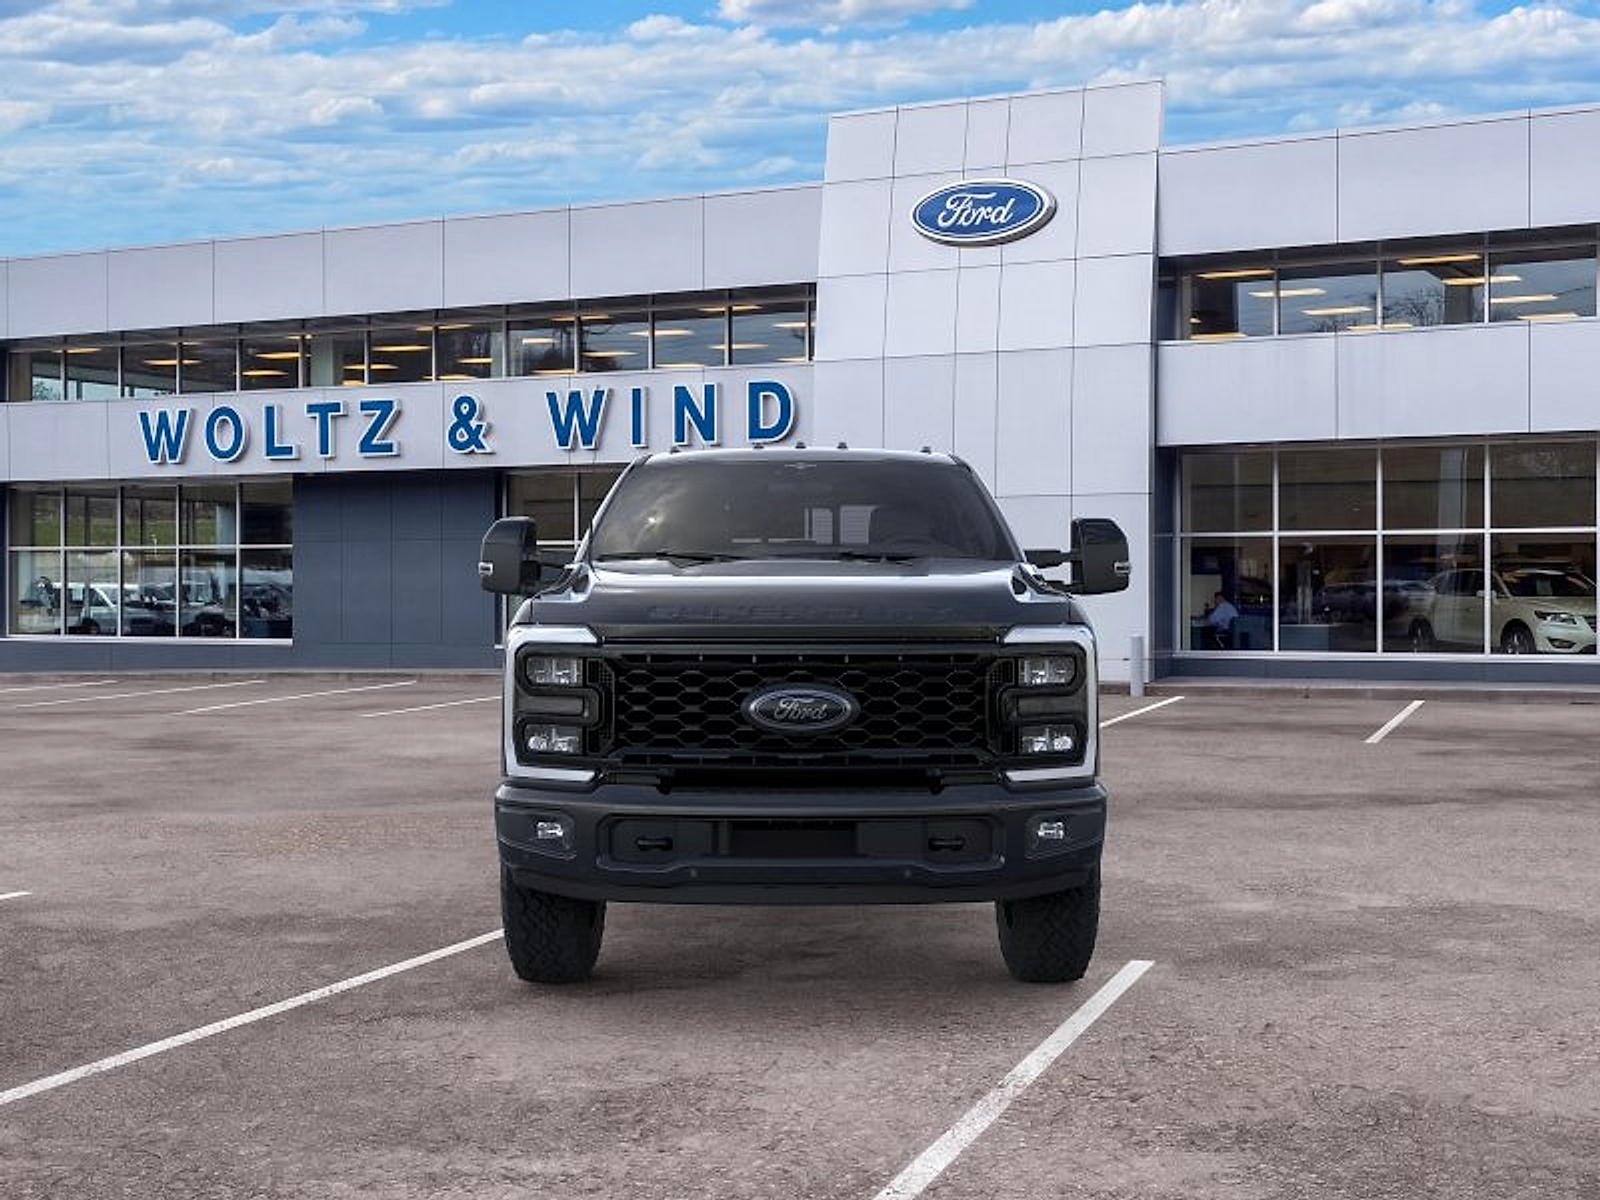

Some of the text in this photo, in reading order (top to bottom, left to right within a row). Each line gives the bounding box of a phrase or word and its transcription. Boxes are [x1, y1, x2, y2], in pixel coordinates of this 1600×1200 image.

[937, 192, 1016, 228] Ford
[138, 379, 795, 463] WOLTZ & WIND
[774, 698, 828, 719] Ford
